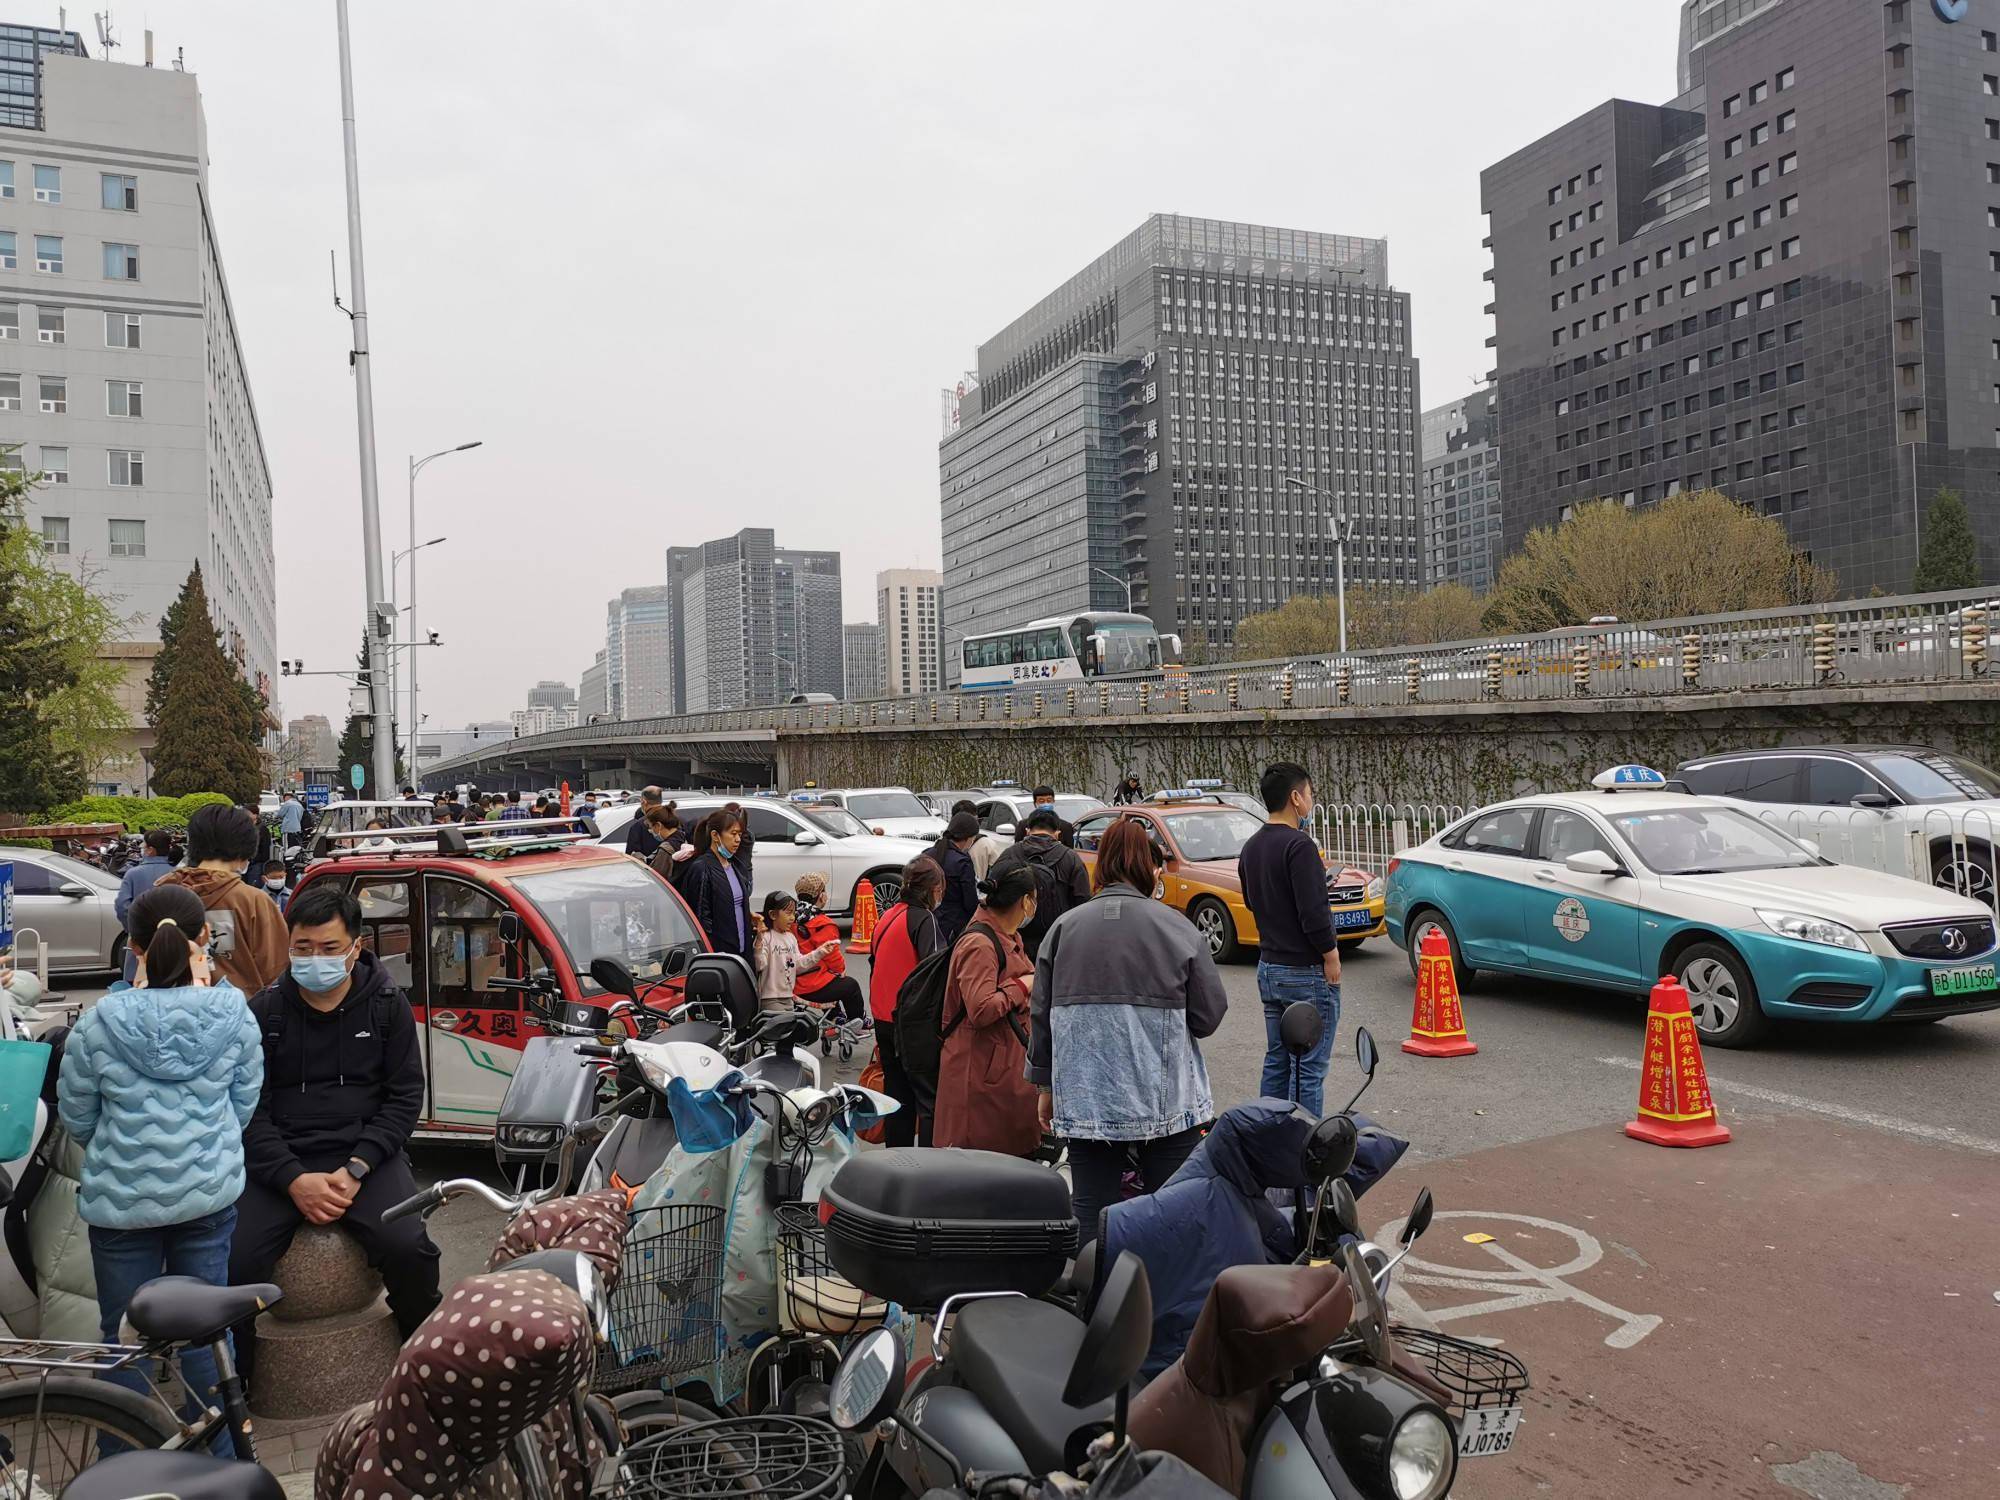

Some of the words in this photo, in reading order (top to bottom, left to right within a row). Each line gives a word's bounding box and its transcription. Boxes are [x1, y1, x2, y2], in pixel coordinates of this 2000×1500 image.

[1144, 351, 1159, 473] 中国联通
[1622, 768, 1652, 781] 延庆
[1437, 962, 1454, 1030] 潜水艇增压泵
[1649, 1018, 1665, 1110] 潜水艇增压泵
[1679, 1033, 1703, 1112] 厨余垃圾处理器
[1460, 1431, 1512, 1454] AJ0785
